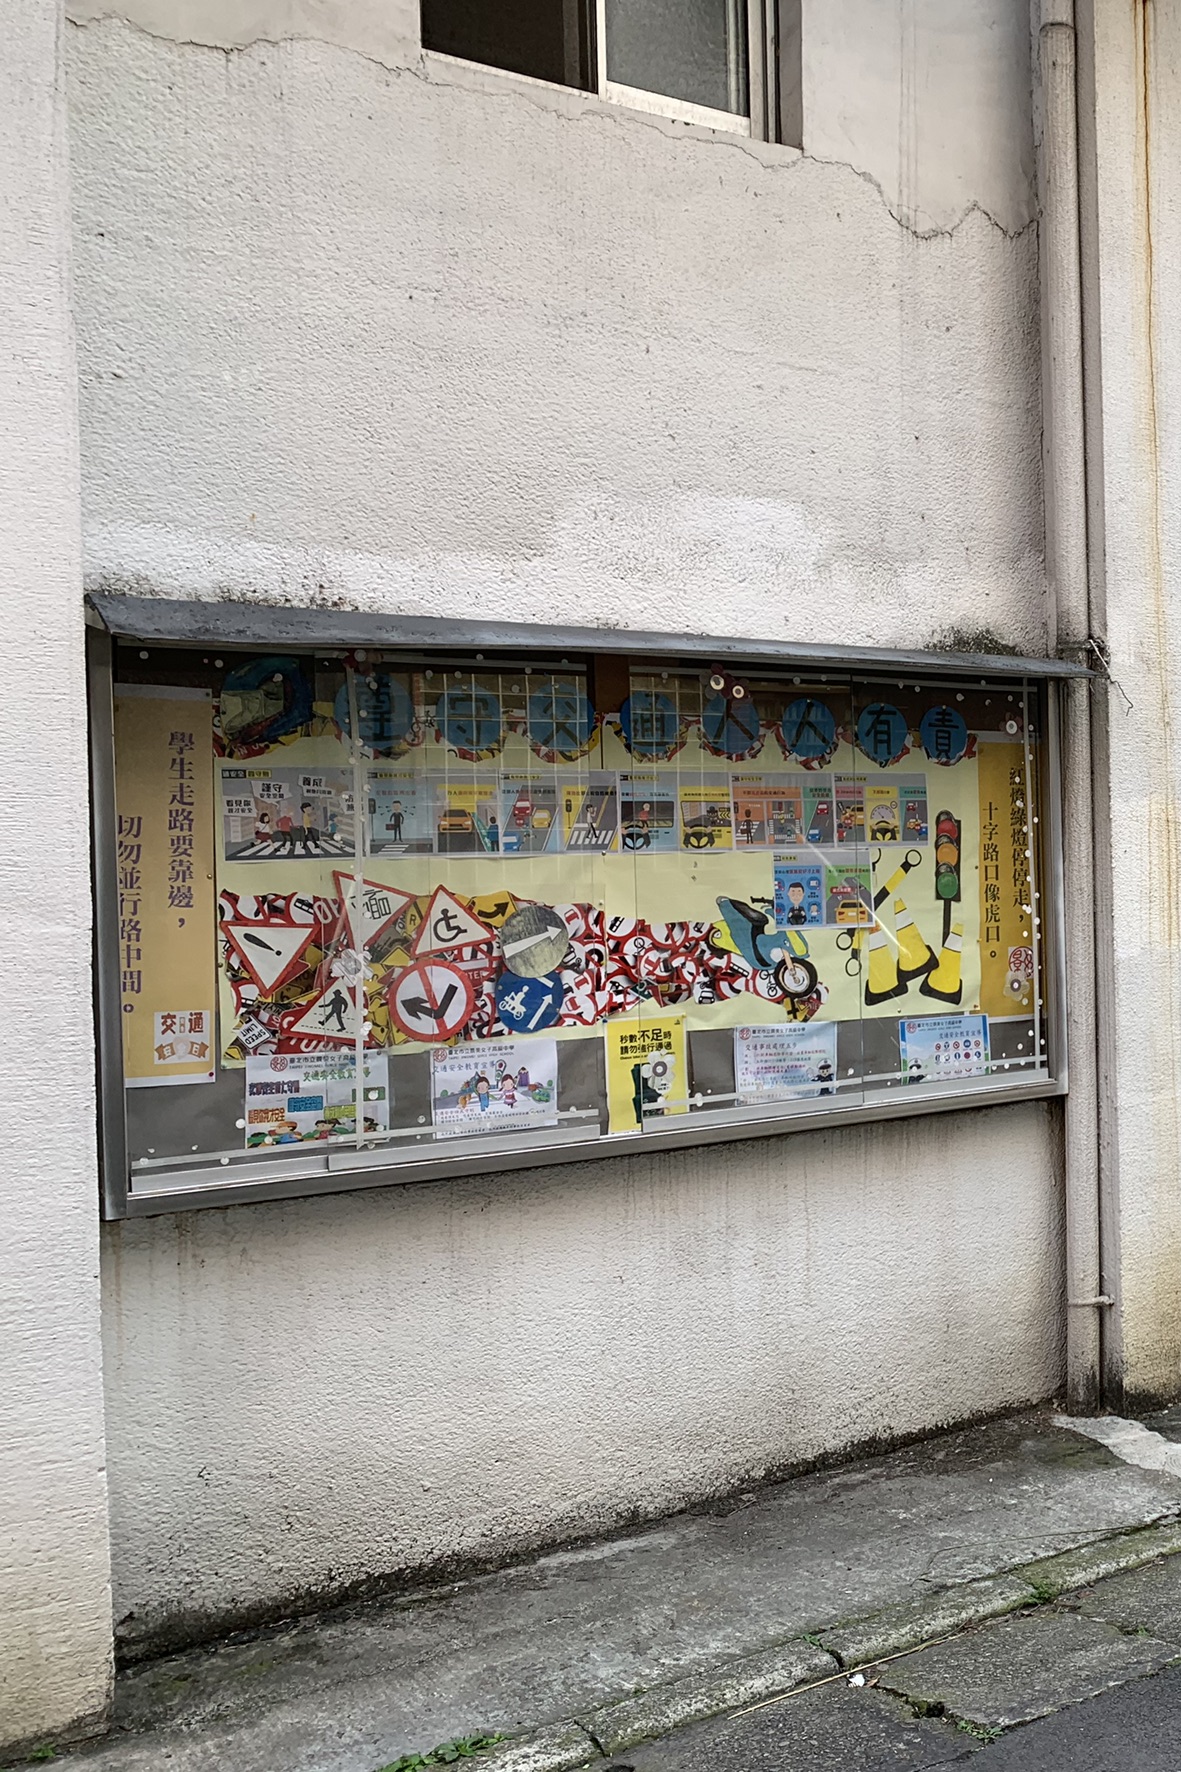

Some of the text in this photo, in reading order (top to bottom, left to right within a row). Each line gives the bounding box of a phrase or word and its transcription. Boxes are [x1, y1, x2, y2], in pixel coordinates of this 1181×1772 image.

[168, 731, 194, 928] 學生走路要靠邊，
[982, 802, 1000, 958] 十字路口像虎口。
[1009, 768, 1029, 923] 紅燈綠燈停停走，
[118, 814, 142, 1013] 切勿並行路中間。
[240, 1024, 259, 1038] LIMIT
[245, 1028, 268, 1045] SPEED
[620, 1028, 671, 1044] 秒數不足時
